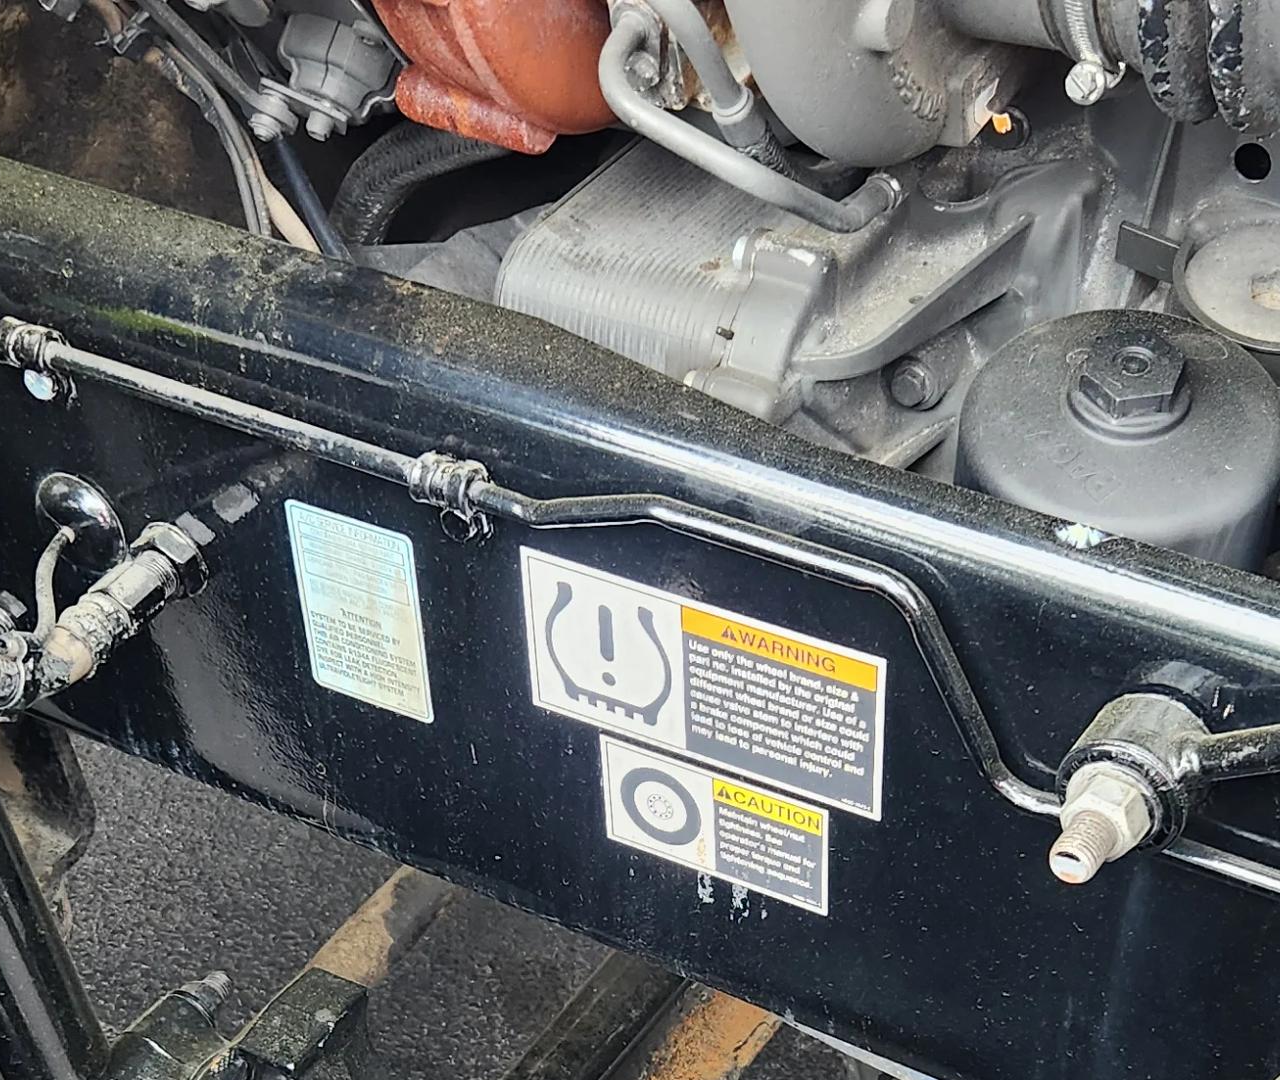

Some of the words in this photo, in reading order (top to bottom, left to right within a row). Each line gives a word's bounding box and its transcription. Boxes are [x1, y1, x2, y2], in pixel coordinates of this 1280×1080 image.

[316, 516, 345, 534] SERVICE
[348, 527, 400, 551] INFORMATION
[310, 610, 336, 624] SYSTEM
[358, 626, 390, 643] SERVICED
[391, 637, 400, 645] BY
[312, 619, 344, 636] QUALIFIED
[340, 608, 381, 629] ATTENTION
[314, 636, 346, 652] CONTAINS
[341, 637, 388, 658] CONDITIONING
[389, 653, 416, 668] SYSTEM
[343, 655, 360, 666] LEAK
[739, 630, 835, 672] WARNING
[688, 639, 709, 653] Use
[711, 648, 733, 663] only
[736, 655, 753, 668] the
[755, 662, 787, 679] wheel
[789, 671, 823, 692] brand,
[825, 685, 848, 698] size
[850, 691, 859, 702] &
[688, 653, 710, 666] part
[712, 660, 728, 672] no.
[731, 665, 776, 687] installed
[777, 680, 792, 694] by
[794, 686, 811, 699] the
[813, 693, 855, 713] original
[689, 665, 744, 689] equipment
[746, 684, 819, 713] manufacturer.
[822, 706, 842, 722] Use
[844, 716, 857, 726] of
[858, 720, 866, 729] a
[689, 677, 733, 697] different
[735, 692, 765, 708] wheel
[767, 701, 799, 719] brand
[801, 714, 812, 723] or
[815, 718, 837, 731] size
[838, 726, 869, 742] could
[690, 690, 721, 705] cause
[723, 700, 750, 715] valve
[752, 710, 778, 724] stem
[780, 718, 792, 729] to
[794, 722, 838, 744] interfere
[840, 738, 863, 752] with
[690, 701, 697, 709] a
[699, 702, 727, 719] brake
[730, 714, 789, 739] component
[790, 734, 822, 750] which
[824, 745, 855, 761] could
[690, 711, 713, 726] lead
[714, 719, 726, 730] to
[728, 723, 749, 738] loss
[751, 733, 763, 742] of
[765, 737, 802, 755] vehicle
[803, 750, 842, 768] control
[844, 763, 864, 776] and
[691, 724, 712, 738] may
[715, 730, 737, 745] lead
[738, 738, 750, 750] to
[751, 745, 797, 765] personal
[799, 758, 832, 777] injury.
[718, 806, 757, 826] Maintain
[759, 822, 805, 842] wheel/nut
[733, 791, 819, 829] CAUTION
[718, 818, 762, 839] tightness.
[765, 833, 782, 846] See
[719, 830, 765, 851] operator's
[767, 847, 801, 863] manual
[802, 857, 816, 868] for
[719, 841, 749, 856] proper
[751, 851, 781, 867] torque
[782, 863, 800, 874] and
[720, 851, 764, 874] tightening
[766, 868, 812, 888] sequence.
